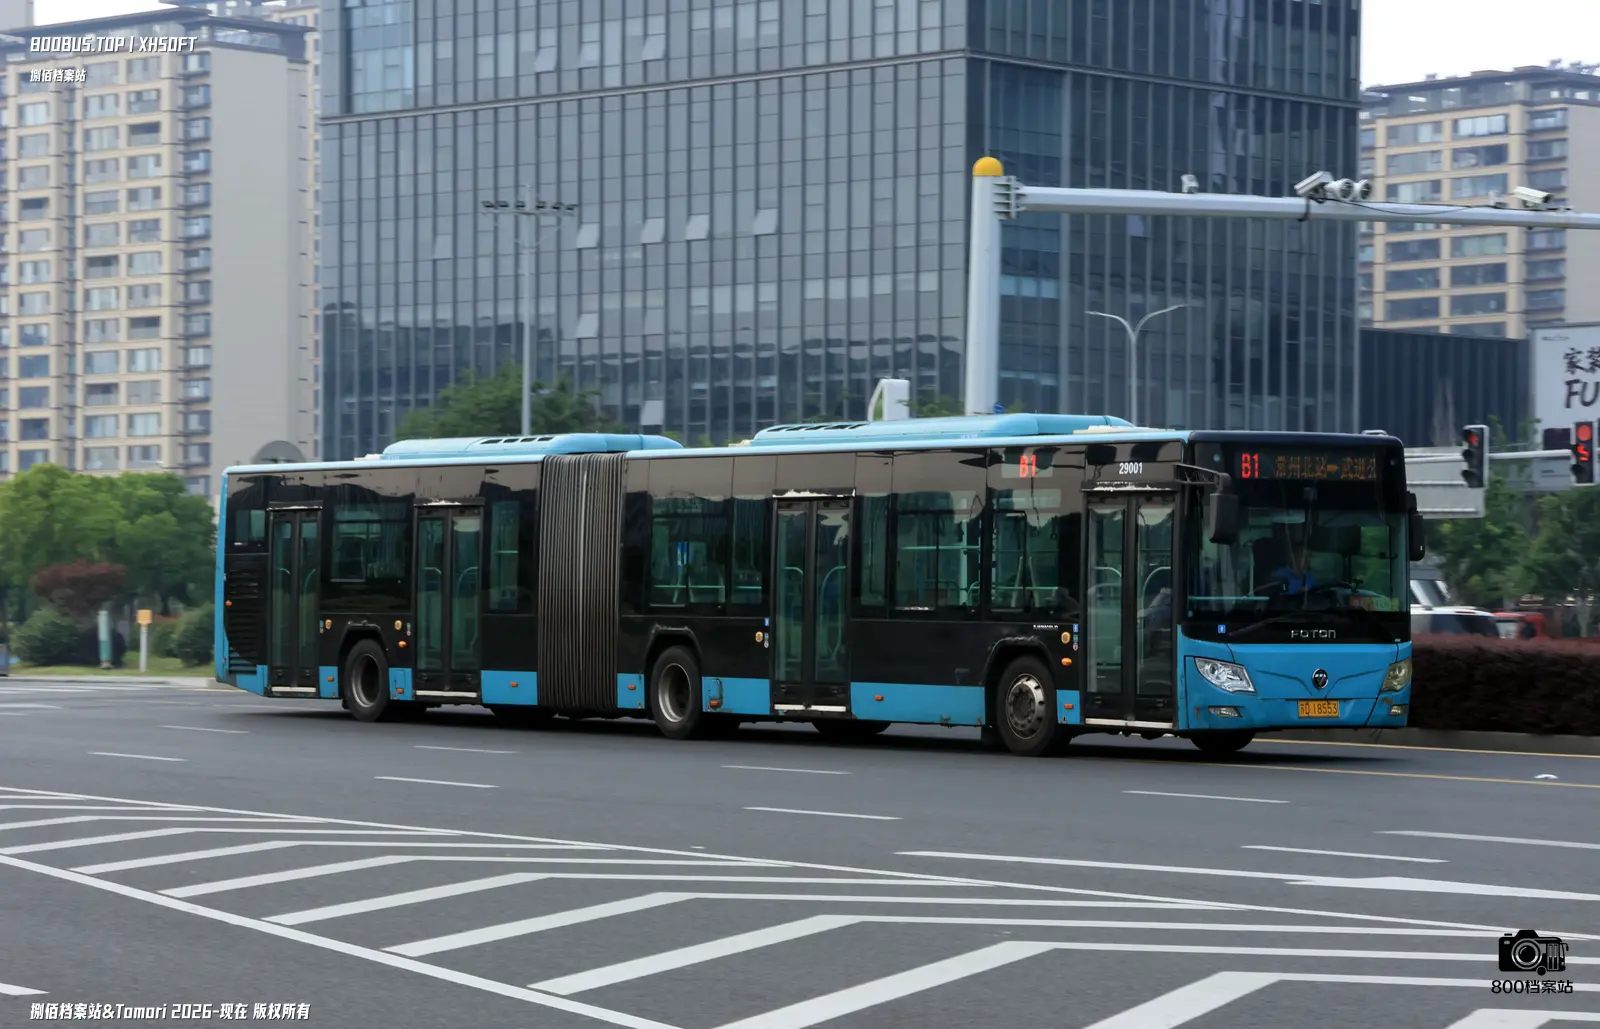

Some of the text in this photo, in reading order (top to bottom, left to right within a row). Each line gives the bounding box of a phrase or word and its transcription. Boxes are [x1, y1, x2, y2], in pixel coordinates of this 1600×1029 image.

[1019, 455, 1037, 478] B1
[1119, 462, 1143, 475] 29001
[1241, 453, 1259, 479] B1
[1291, 629, 1336, 639] FOTON
